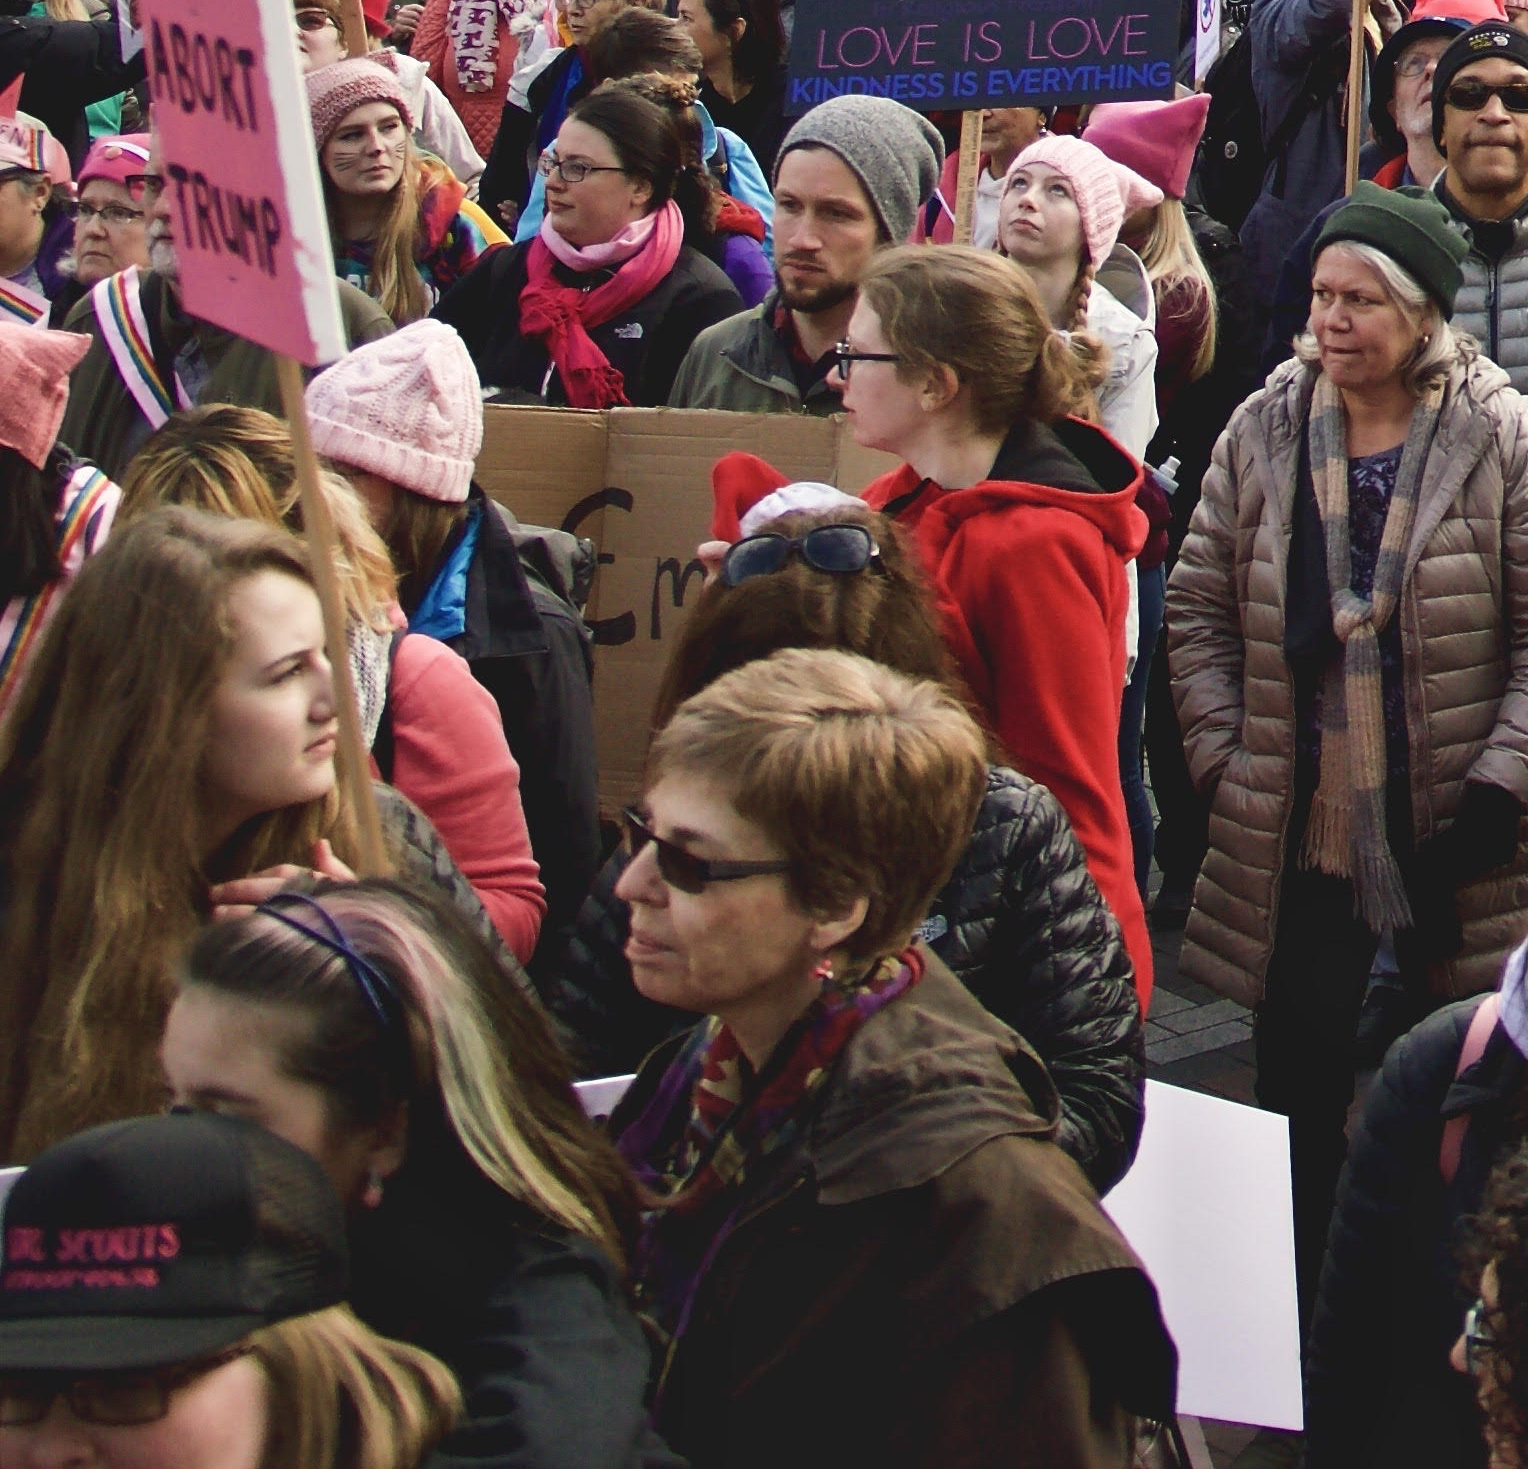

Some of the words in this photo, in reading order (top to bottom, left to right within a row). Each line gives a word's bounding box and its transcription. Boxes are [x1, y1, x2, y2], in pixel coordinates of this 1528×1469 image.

[149, 17, 259, 132] ABORT
[817, 23, 938, 70] LOVE
[963, 21, 1002, 63] IS
[1026, 14, 1150, 61] LOVE
[952, 69, 977, 97] IS
[987, 62, 1172, 96] EVERYTHING
[166, 163, 280, 278] TRUMP
